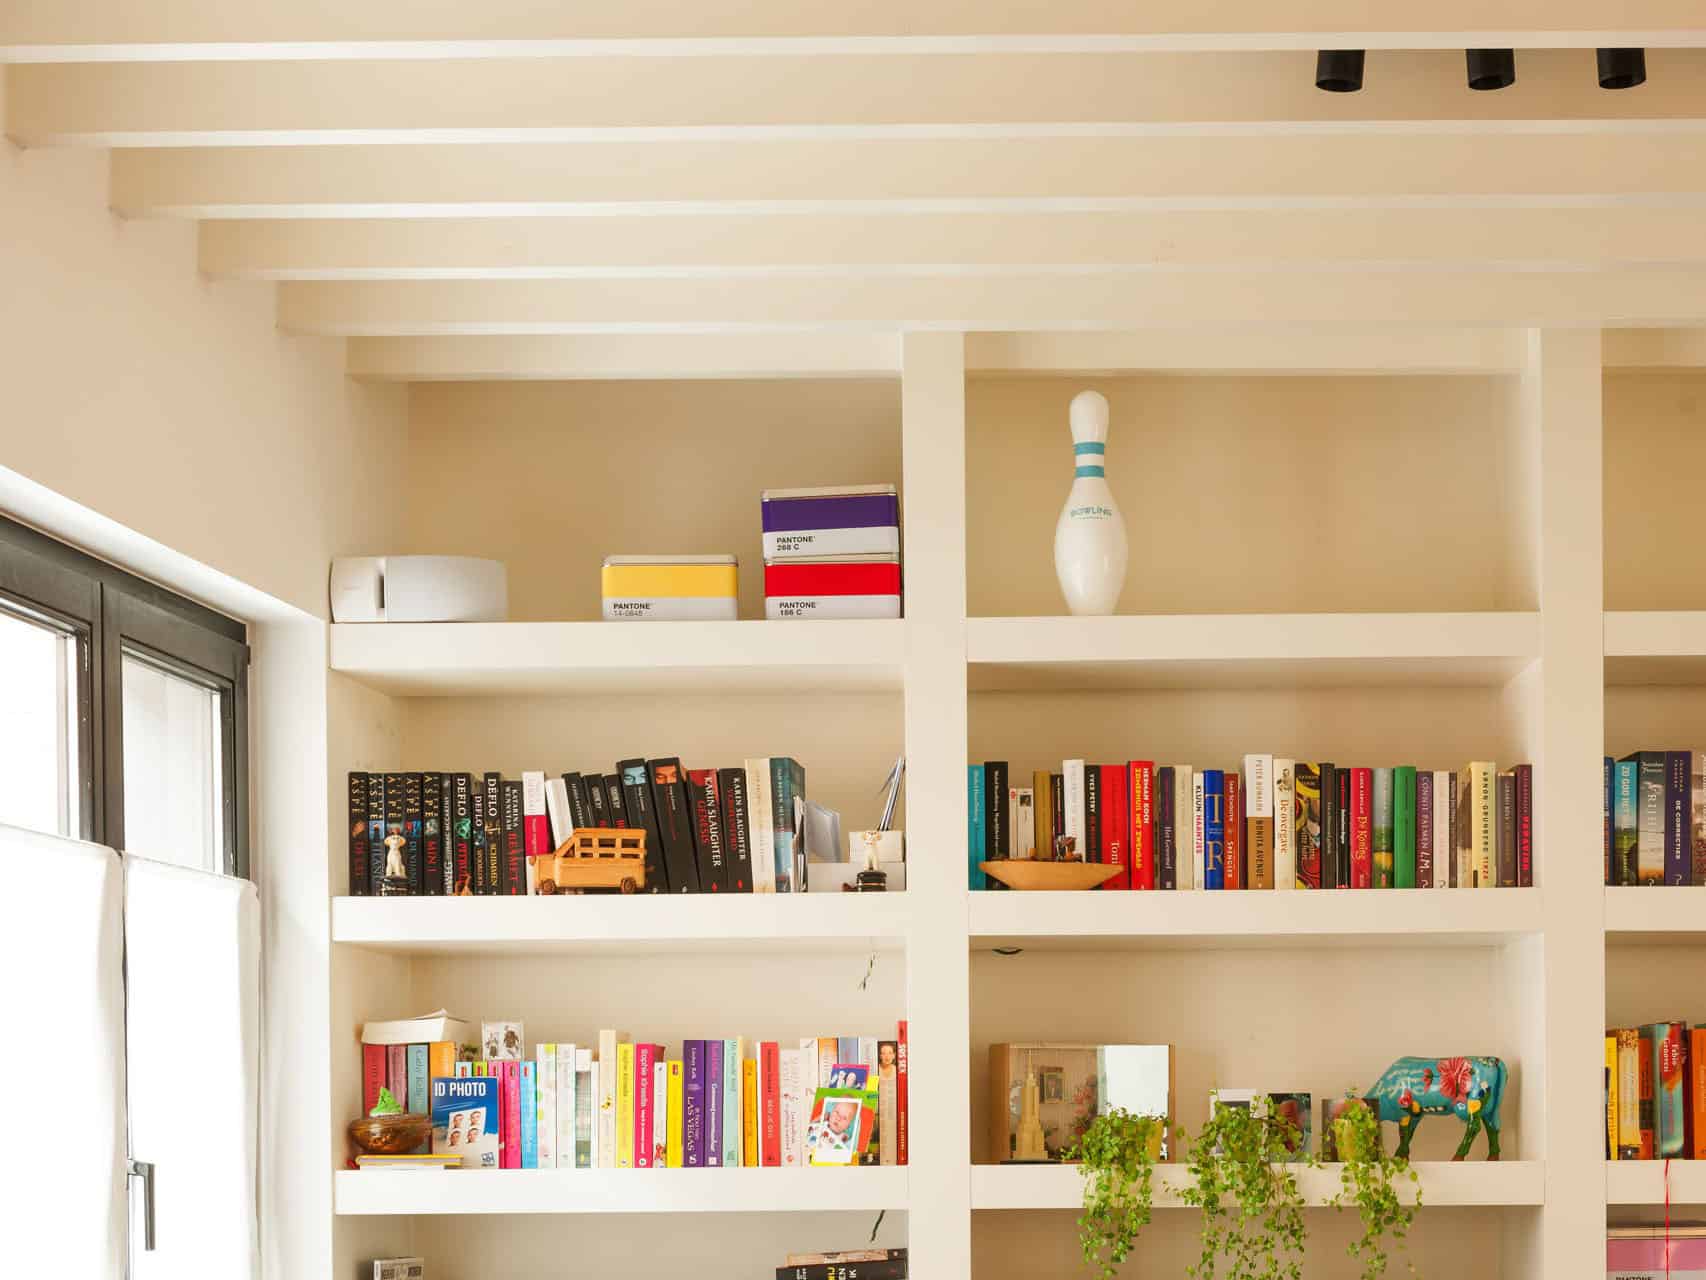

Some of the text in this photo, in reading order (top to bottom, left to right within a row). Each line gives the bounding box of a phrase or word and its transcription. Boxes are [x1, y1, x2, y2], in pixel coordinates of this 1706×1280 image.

[776, 536, 814, 544] PANTONE
[352, 778, 360, 813] ASPE
[369, 777, 377, 819] ASPE
[388, 776, 396, 817] ASPE
[406, 778, 414, 813] ASPE
[425, 776, 433, 816] ASPE
[457, 777, 466, 816] DEFLO
[488, 779, 497, 816] DEFLO
[1280, 800, 1288, 811] De
[1675, 800, 1680, 810] DE
[705, 776, 721, 867] KARIN SLAUGHTER
[733, 777, 746, 860] KARIN SLAUGHTER
[1357, 816, 1368, 829] De
[1255, 820, 1264, 848] BONITA
[1356, 830, 1367, 860] Koning
[1111, 840, 1120, 864] Toni
[1255, 850, 1264, 879] AVENUE
[434, 1082, 486, 1096] ID PHOTO
[838, 1268, 846, 1280] EN
[849, 1269, 857, 1278] IK
